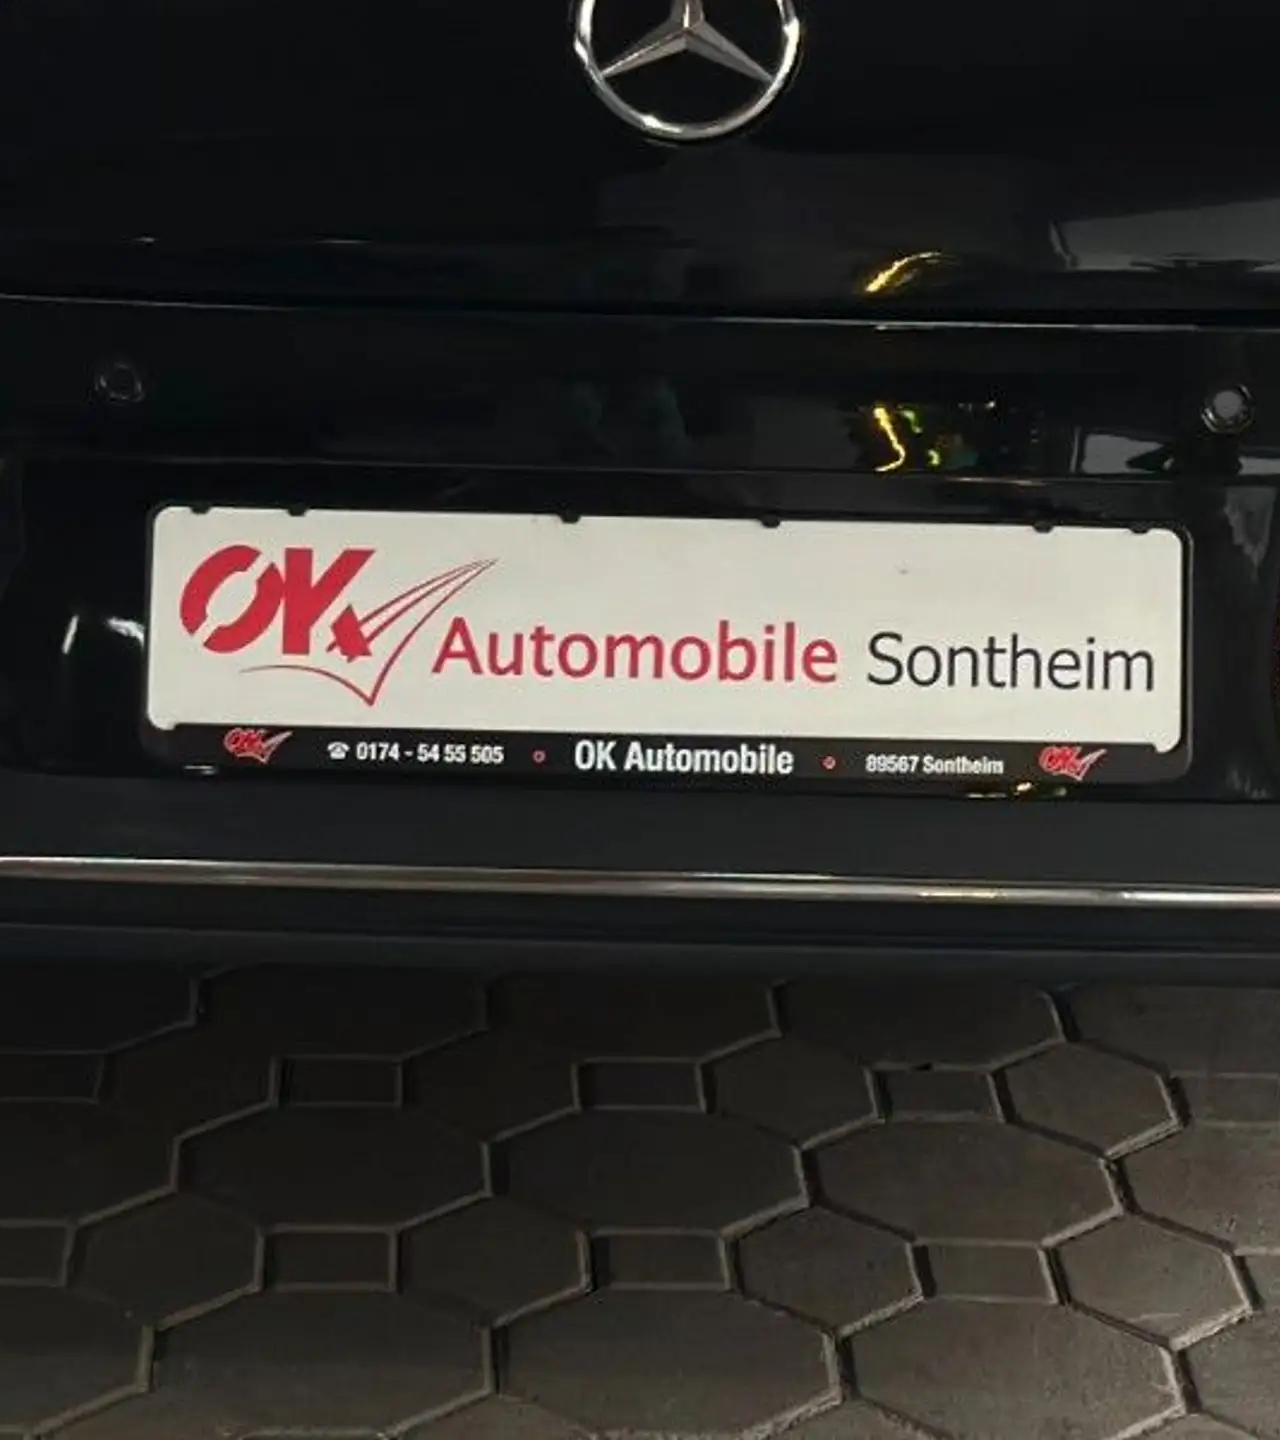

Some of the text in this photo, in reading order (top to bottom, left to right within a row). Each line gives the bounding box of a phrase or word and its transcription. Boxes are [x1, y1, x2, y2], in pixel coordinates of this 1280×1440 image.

[179, 544, 1155, 692] OK Automobile Sontheim
[355, 742, 400, 761] 0174
[417, 744, 441, 762] 54
[443, 744, 468, 763] 55
[470, 745, 505, 764] 505
[574, 740, 794, 774] OK Automobile
[865, 753, 1005, 775] 89567 Sontheim
